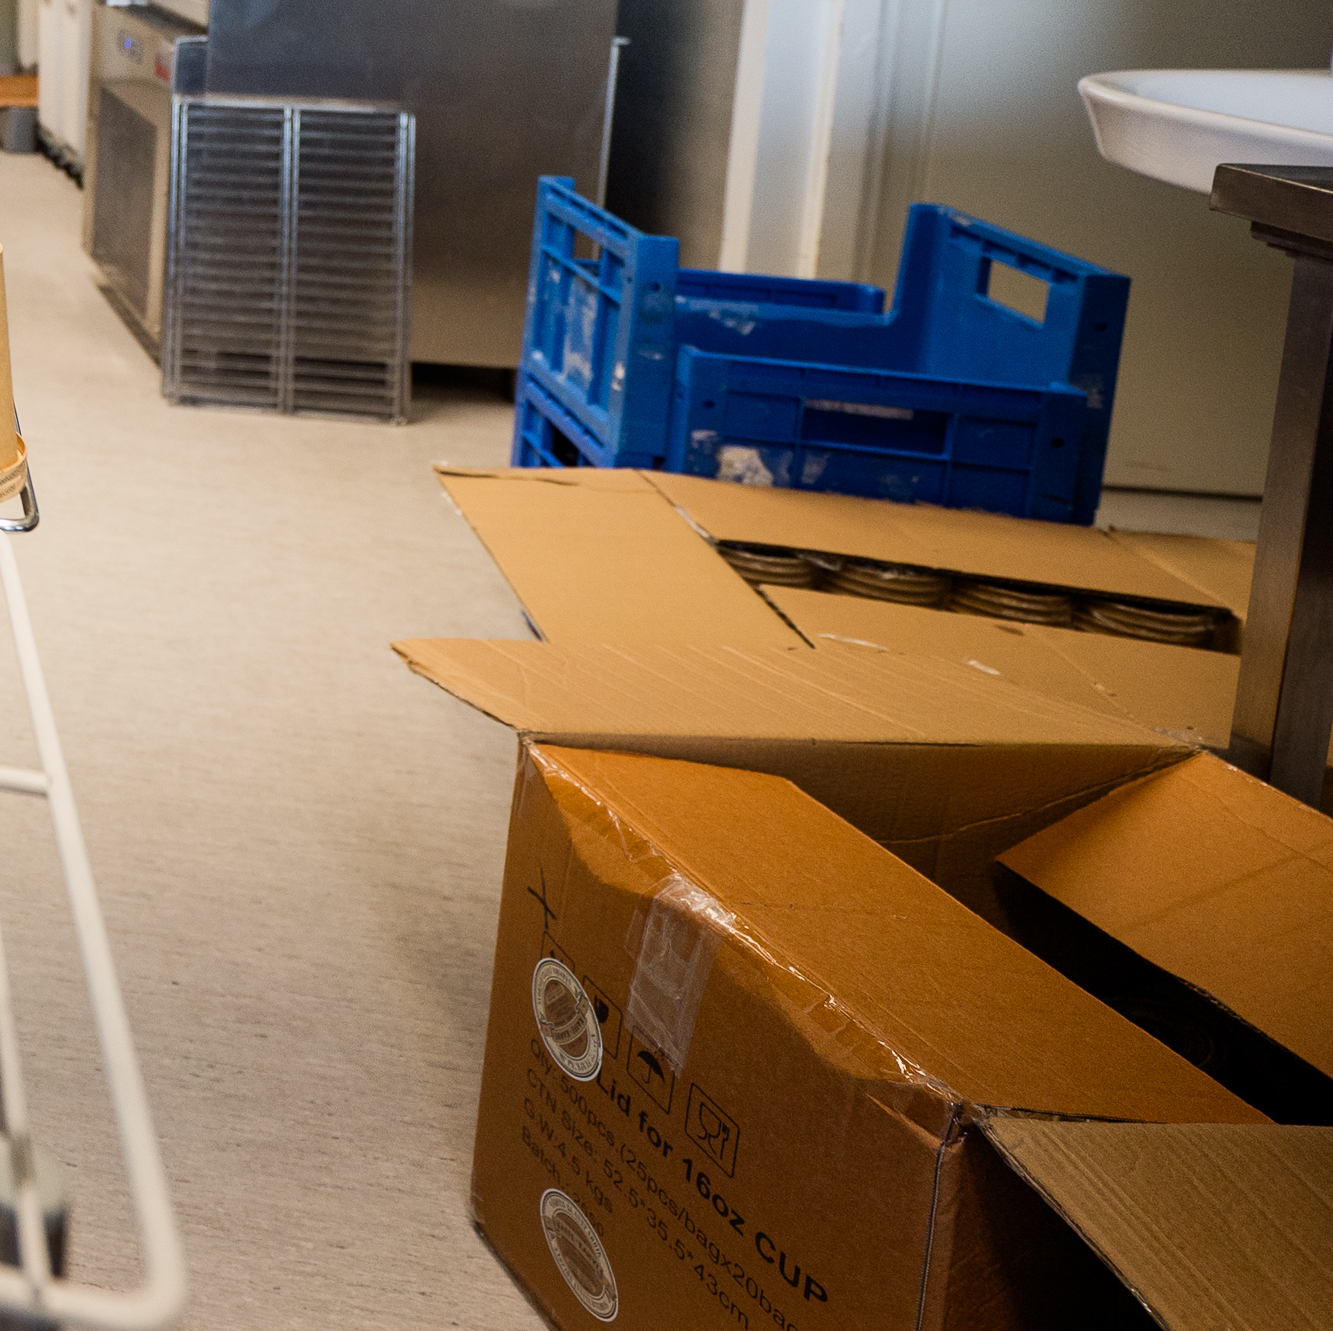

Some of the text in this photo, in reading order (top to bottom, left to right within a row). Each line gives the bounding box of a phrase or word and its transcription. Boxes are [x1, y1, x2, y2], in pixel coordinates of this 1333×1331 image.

[596, 1070, 828, 1303] Lid for 16oz CUP
